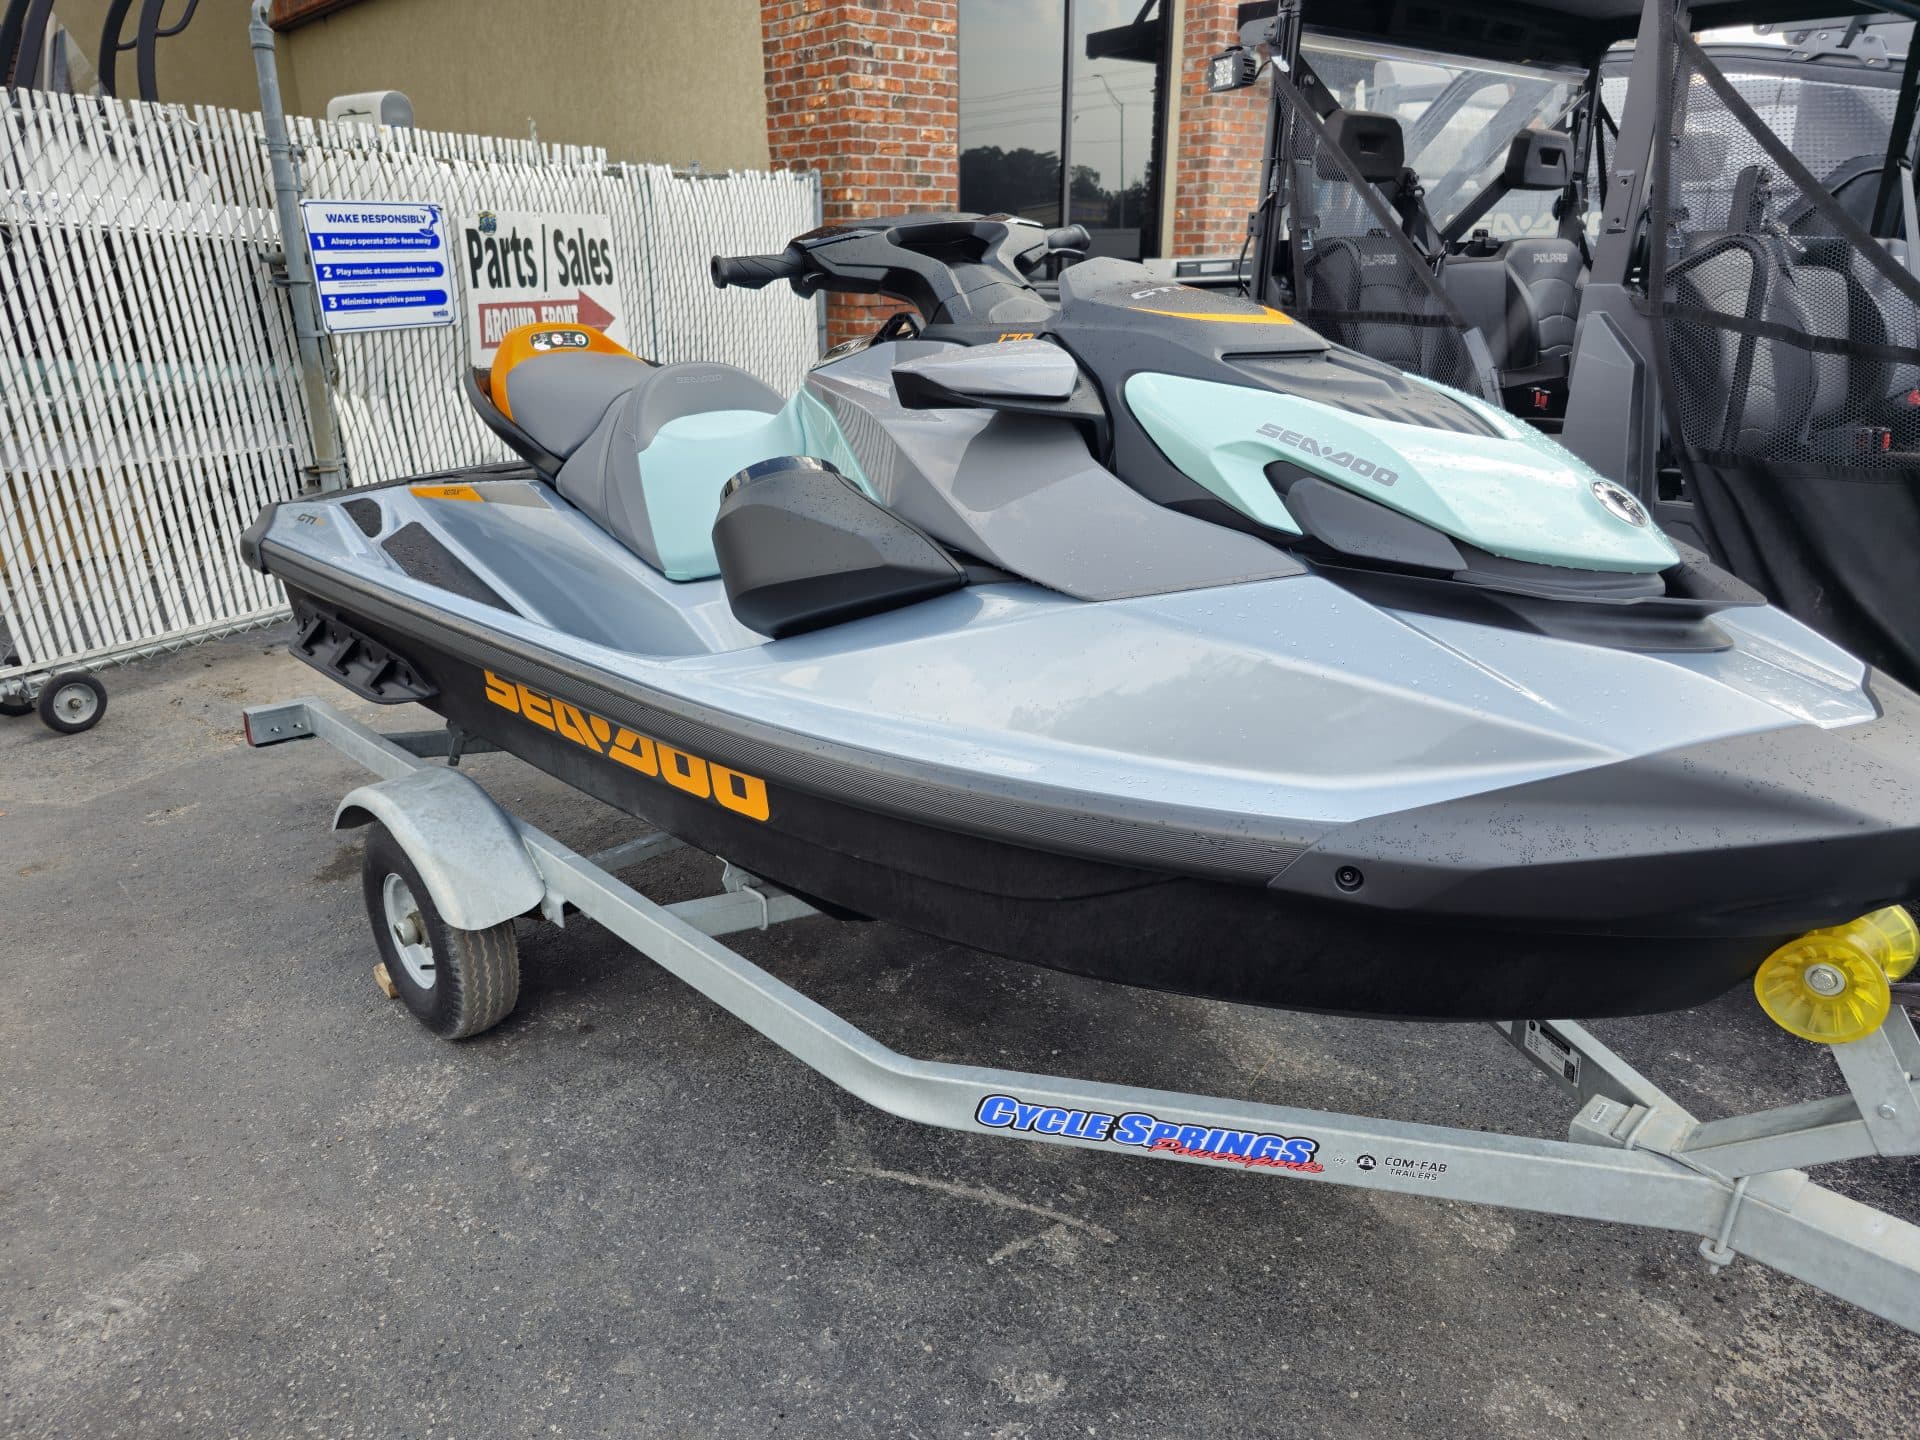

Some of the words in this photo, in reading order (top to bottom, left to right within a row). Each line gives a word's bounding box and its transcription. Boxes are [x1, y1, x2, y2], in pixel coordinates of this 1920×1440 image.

[326, 214, 360, 223] WAKE
[361, 214, 426, 224] RESPONSIBLY
[317, 236, 326, 248] 1
[331, 238, 357, 247] Always
[357, 238, 384, 247] operate
[401, 237, 413, 245] feet
[414, 238, 432, 247] away
[465, 226, 538, 290] Parts
[553, 227, 614, 288] Sales
[322, 266, 333, 279] 2
[336, 268, 352, 277] Play
[352, 267, 373, 275] music
[381, 266, 416, 275] reasonable
[416, 265, 435, 273] levels
[328, 297, 338, 309] 3
[341, 297, 372, 306] Minimize
[373, 296, 404, 306] repetitive
[976, 1095, 1115, 1142] CYCLE
[1112, 1113, 1318, 1165] SPRINGS
[1149, 1138, 1326, 1174] Powersports
[1384, 1156, 1448, 1173] COM-FAB
[1389, 1168, 1438, 1181] TRAILERS
